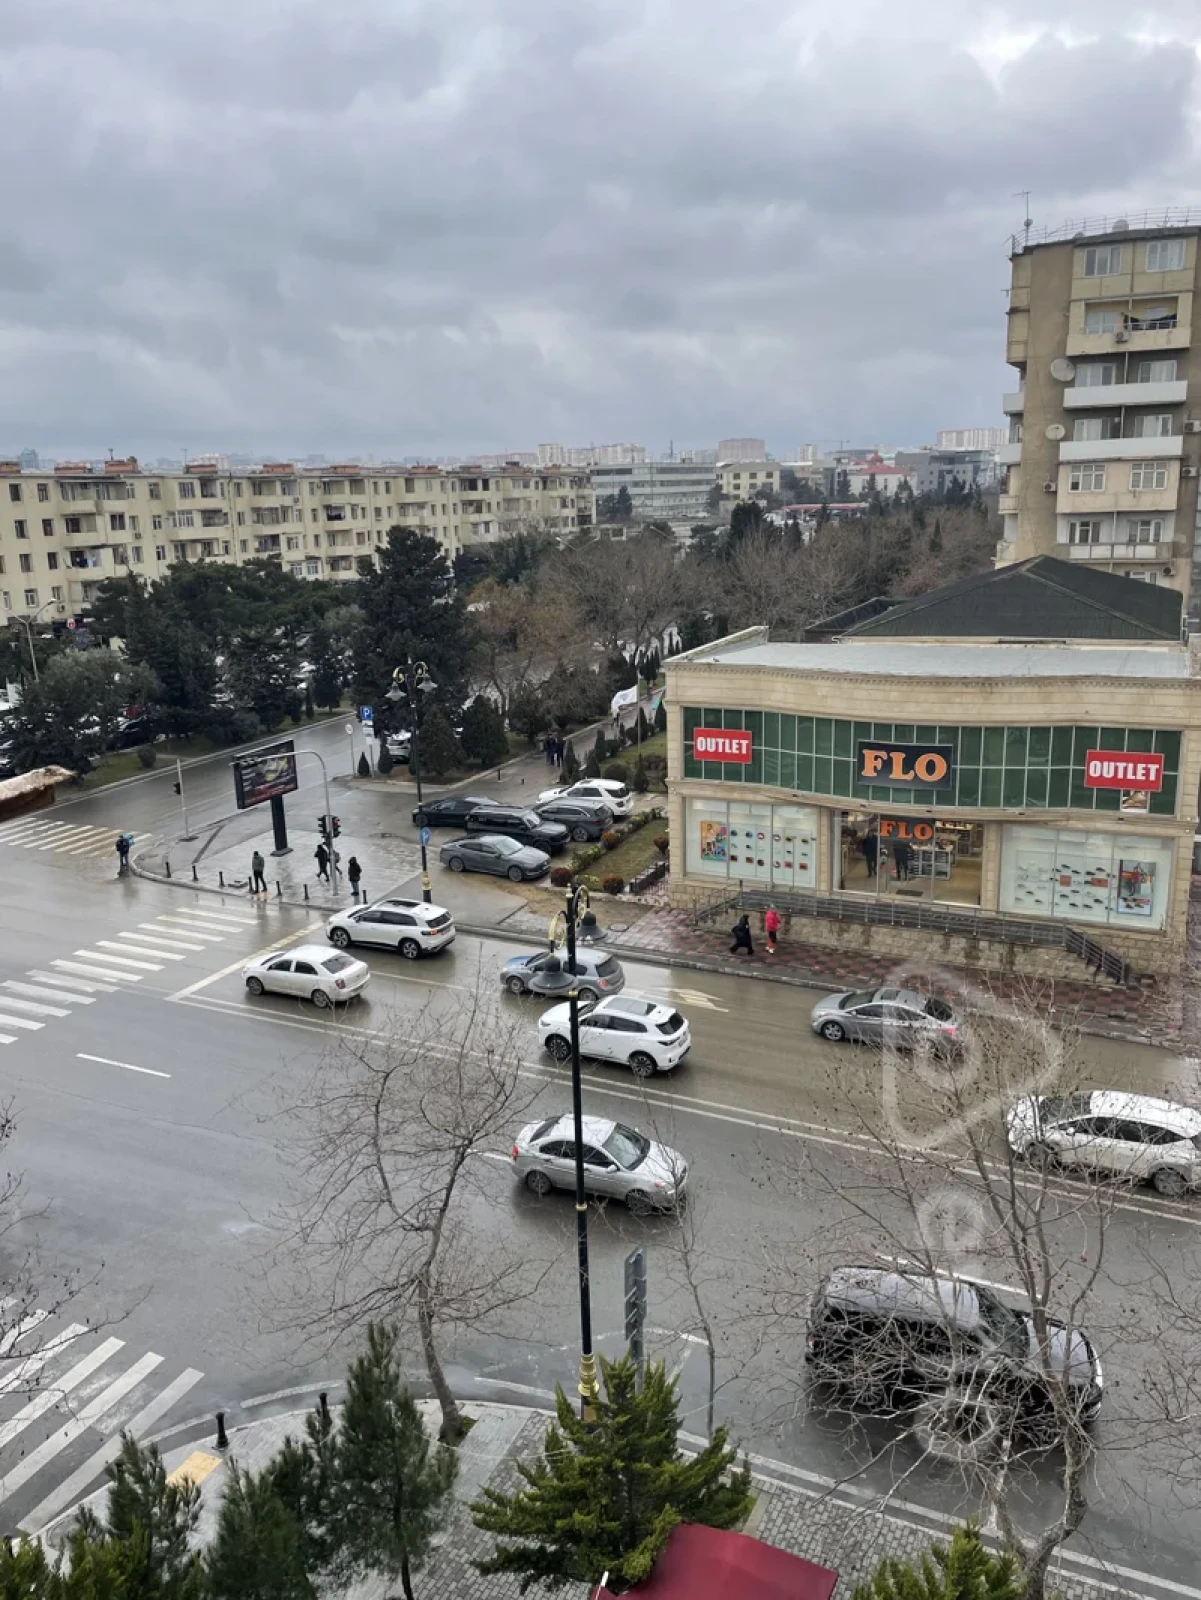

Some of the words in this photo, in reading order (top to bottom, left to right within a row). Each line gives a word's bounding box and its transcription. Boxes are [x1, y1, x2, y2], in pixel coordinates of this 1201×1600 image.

[696, 736, 750, 755] OUTLET
[861, 749, 948, 782] FLO
[1089, 760, 1160, 781] OUTLET
[880, 819, 934, 841] FLO
